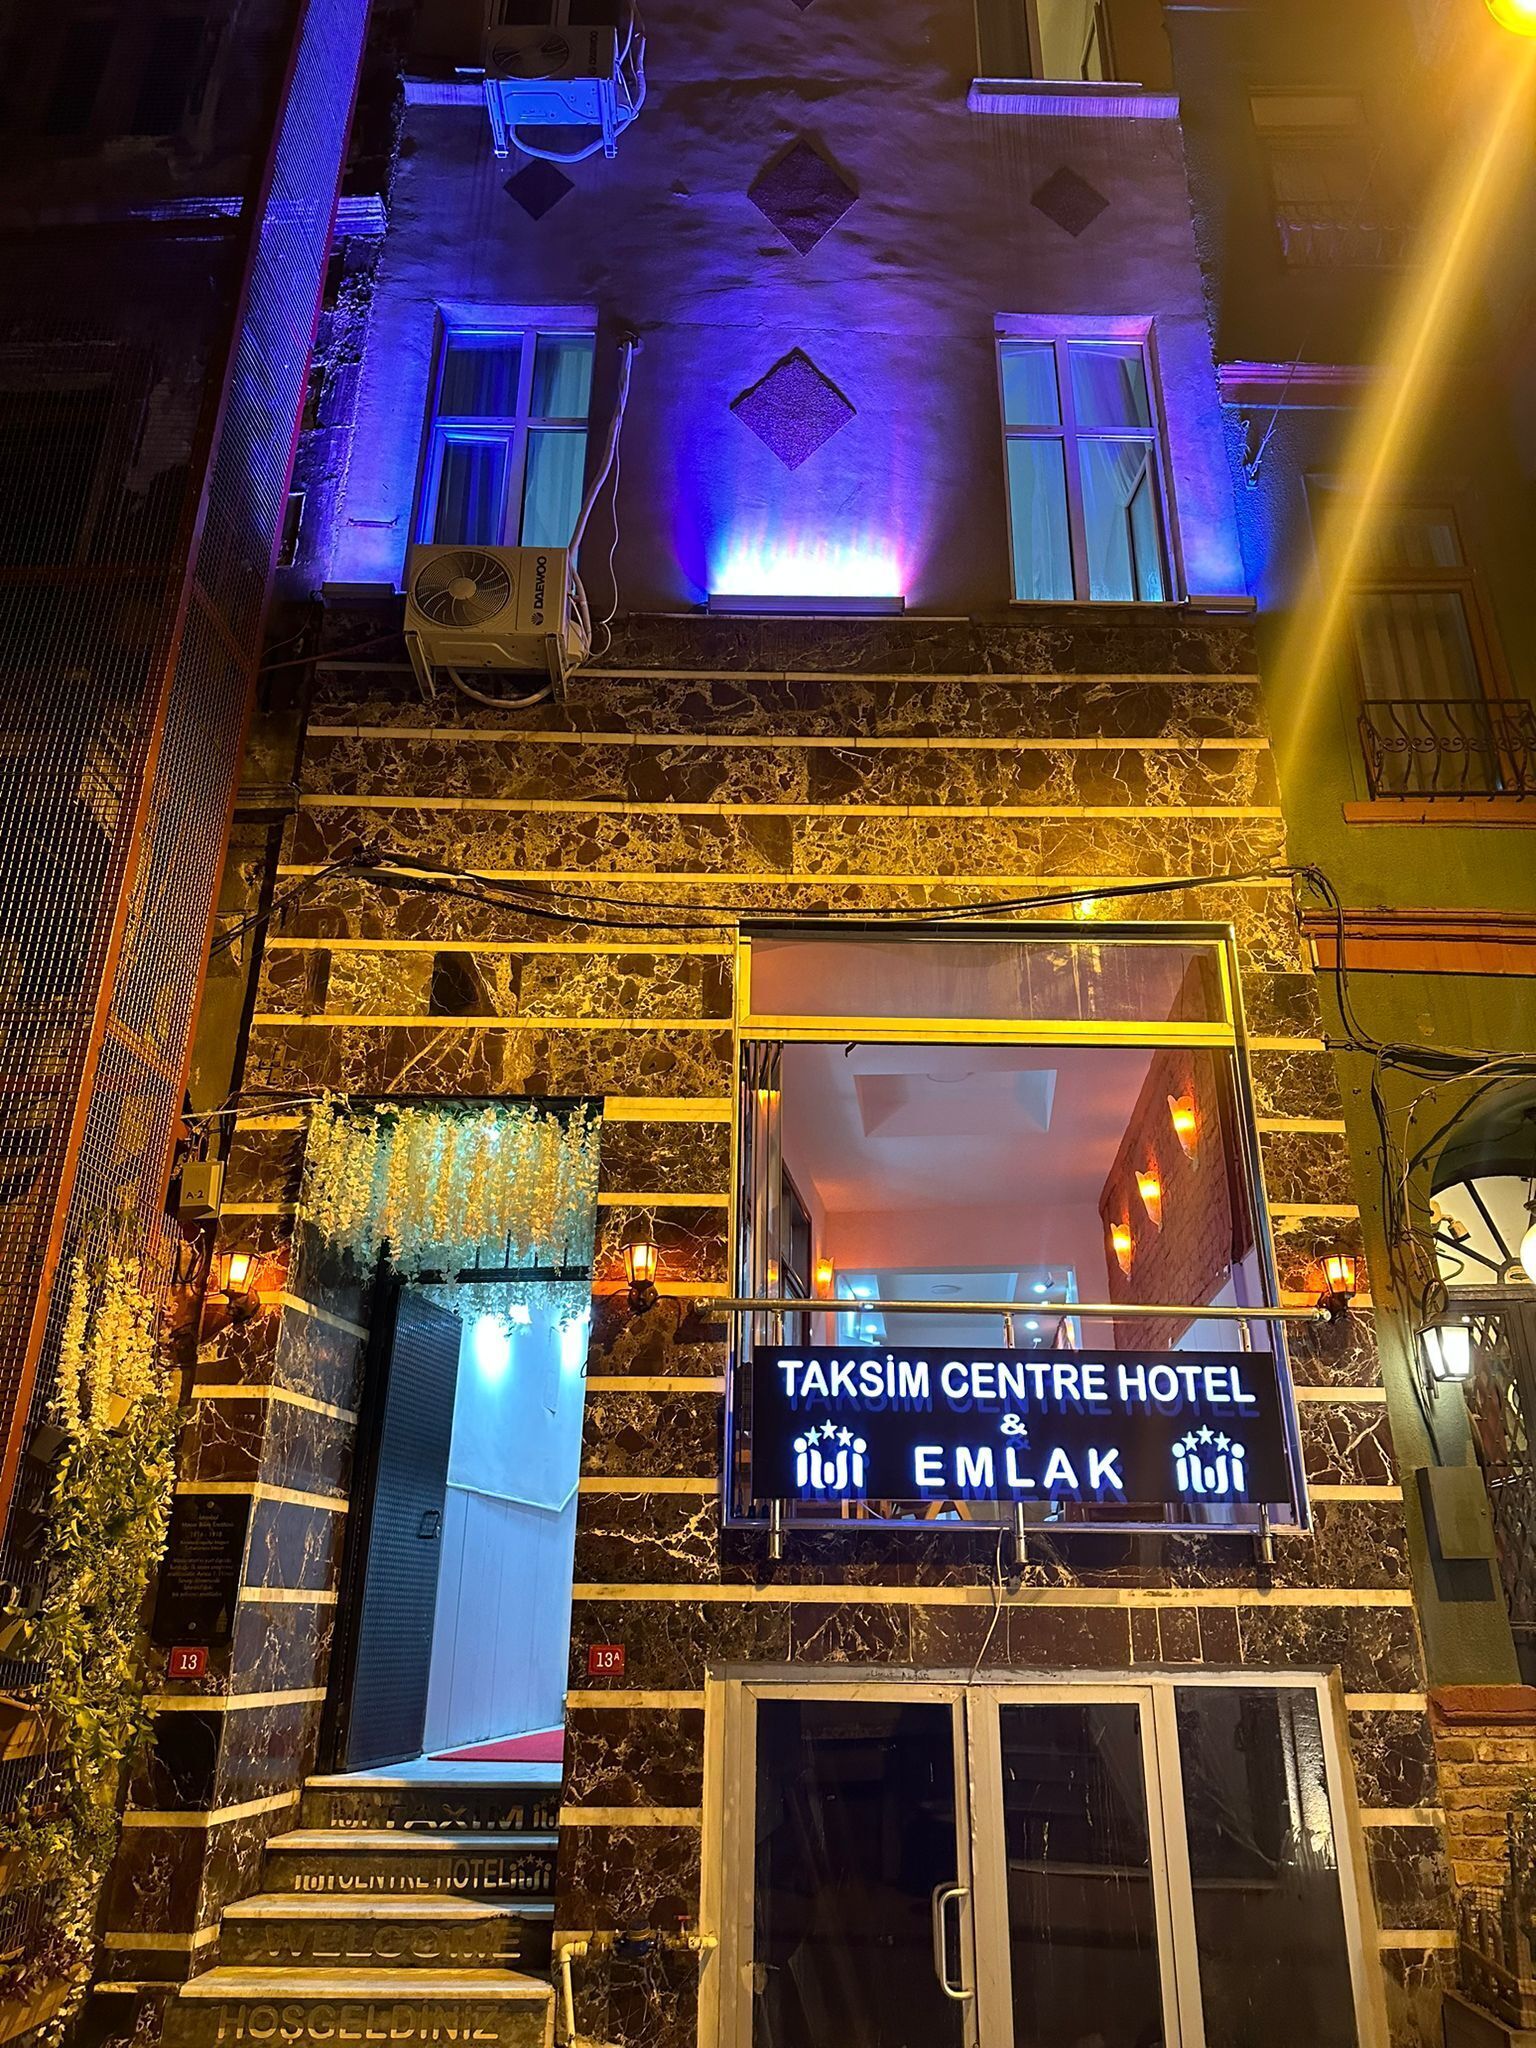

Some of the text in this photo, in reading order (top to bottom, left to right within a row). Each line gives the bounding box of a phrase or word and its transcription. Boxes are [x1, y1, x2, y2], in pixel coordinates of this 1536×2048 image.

[534, 556, 547, 609] DAEWOO
[777, 1354, 1256, 1403] TAKSİM CENTRE HOTEL
[1000, 1413, 1028, 1436] &
[914, 1445, 1124, 1490] EMLAK
[180, 1654, 198, 1670] 13
[338, 1858, 511, 1889] CENTRE HOTEL
[265, 1924, 521, 1959] WELCOME
